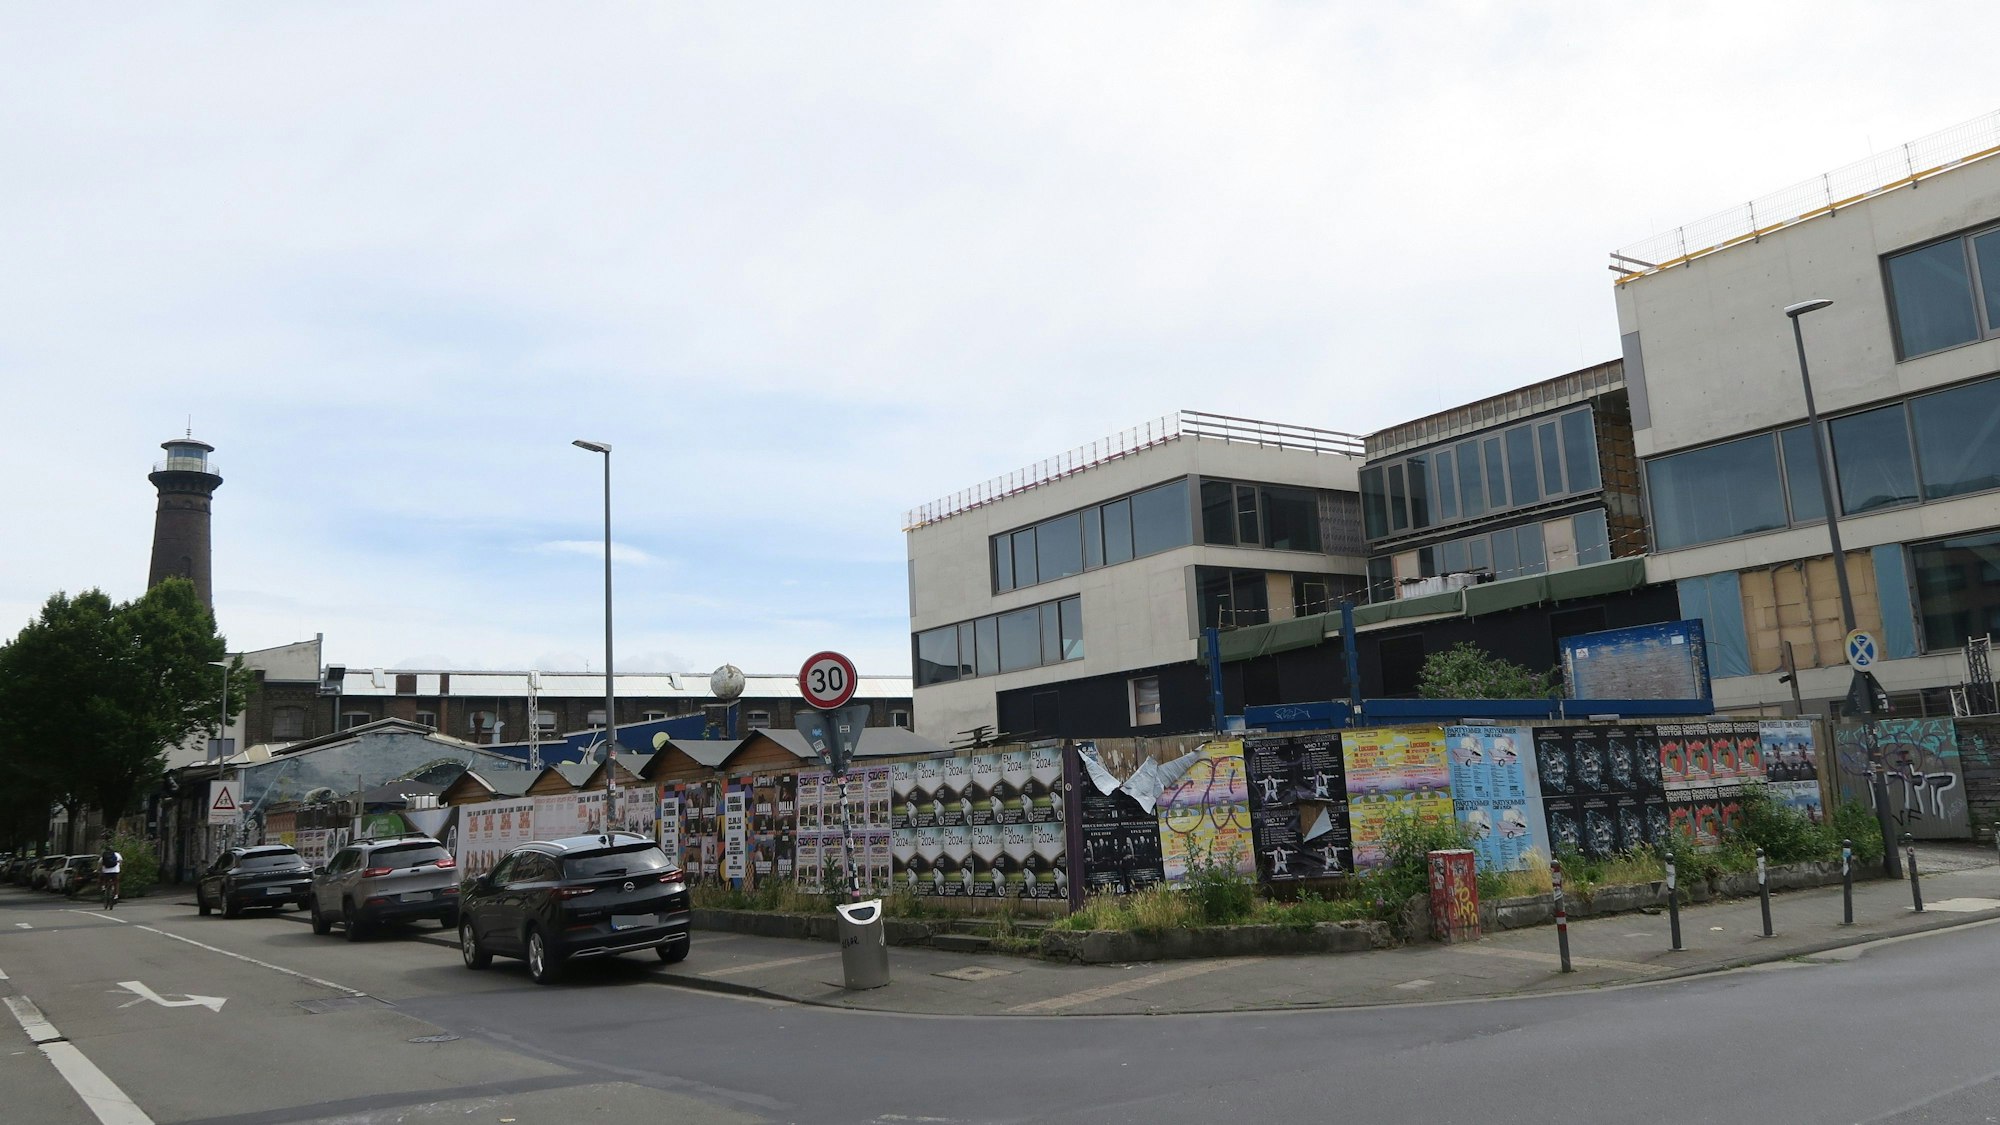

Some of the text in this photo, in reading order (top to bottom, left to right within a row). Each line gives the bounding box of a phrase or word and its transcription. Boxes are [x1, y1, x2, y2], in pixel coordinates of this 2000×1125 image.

[811, 667, 843, 693] 30
[1004, 754, 1012, 763] EM
[1032, 751, 1040, 760] EM
[974, 757, 982, 765] EM
[1036, 759, 1051, 769] 2024
[949, 767, 963, 776] 2024
[978, 765, 992, 774] 2024
[1008, 762, 1022, 772] 2024
[895, 772, 908, 780] 2024
[922, 770, 935, 778] 2024
[779, 801, 793, 811] DILLA
[974, 827, 982, 836] EM
[1005, 826, 1013, 835] EM
[1034, 825, 1043, 834] EM
[896, 838, 908, 846] 2024
[922, 837, 934, 846] 2024
[949, 836, 963, 845] 2024
[978, 835, 992, 845] 2024
[1009, 835, 1024, 844] 2024
[1039, 834, 1053, 844] 2024
